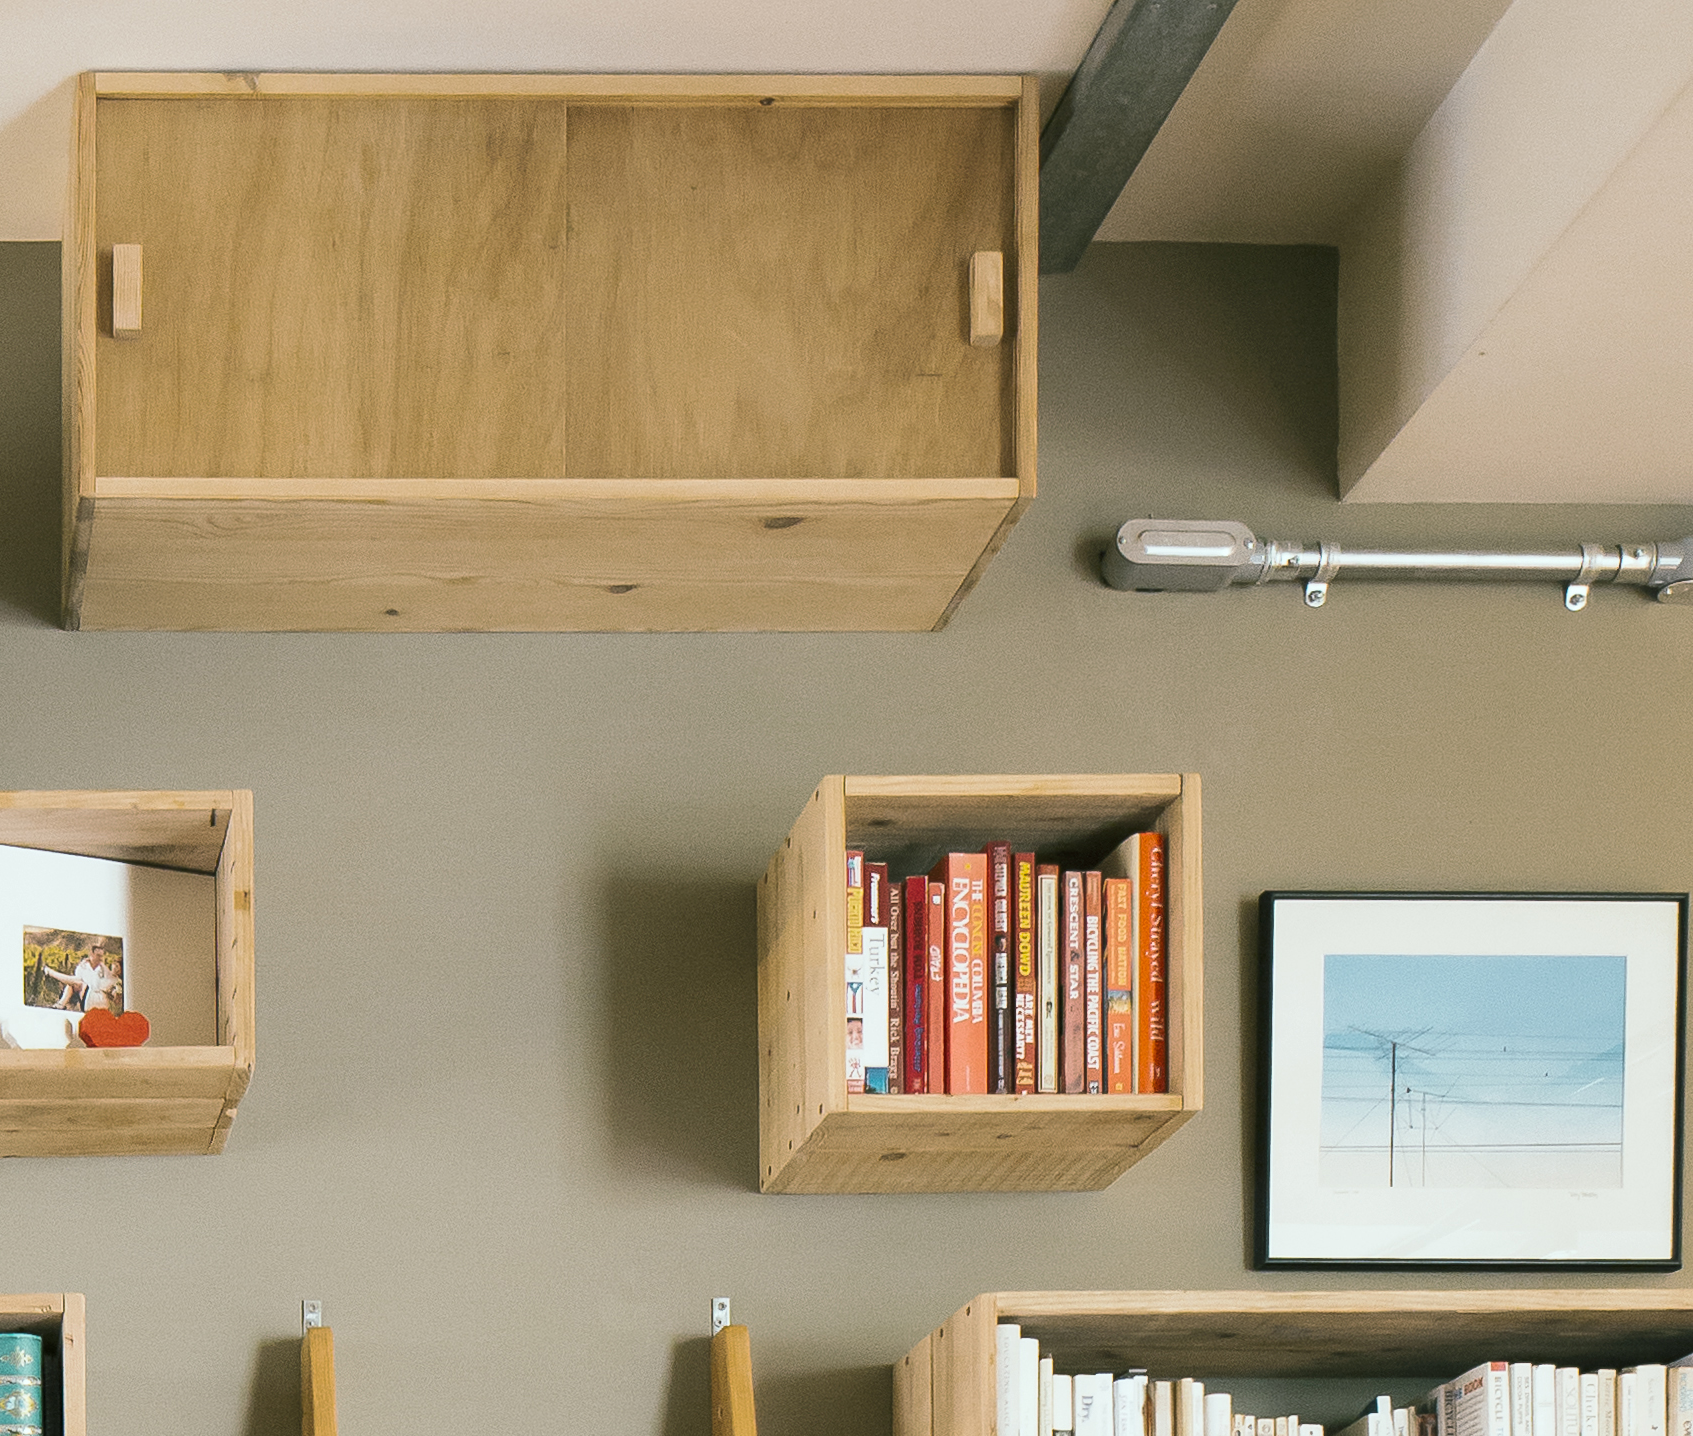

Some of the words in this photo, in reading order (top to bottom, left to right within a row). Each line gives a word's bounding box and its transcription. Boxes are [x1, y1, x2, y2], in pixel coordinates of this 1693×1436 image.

[890, 888, 899, 904] All
[972, 879, 983, 901] THE
[1018, 861, 1031, 928] MAUREEN
[1117, 884, 1127, 908] FAST
[1146, 847, 1163, 908] Cheryl
[889, 906, 899, 931] Over
[972, 904, 983, 956] CONCISE
[1069, 877, 1079, 949] CRESCENT
[1117, 914, 1127, 942] FOOD
[890, 933, 899, 949] but
[953, 877, 969, 1023] ENCYCLOPEDIA
[1019, 931, 1031, 976] DOWD
[1070, 950, 1080, 962] &
[1087, 916, 1099, 971] BICYCLING
[1145, 913, 1164, 983] Strayed
[866, 934, 884, 995] Turkey
[890, 952, 899, 968] the
[1117, 947, 1127, 986] NATION
[972, 958, 983, 1024] COLUMBIA
[1069, 964, 1079, 999] STAR
[1087, 973, 1099, 992] THE
[1025, 994, 1034, 1015] ARE
[1087, 995, 1100, 1035] PACIFIC
[1150, 1000, 1164, 1041] wild
[890, 1018, 899, 1042] Rick
[1016, 993, 1026, 1059] NECESSARY?
[1025, 1019, 1034, 1043] MEN
[887, 1047, 899, 1078] Bragg
[1087, 1037, 1100, 1069] COAST
[1494, 1376, 1505, 1422] BICYCLE
